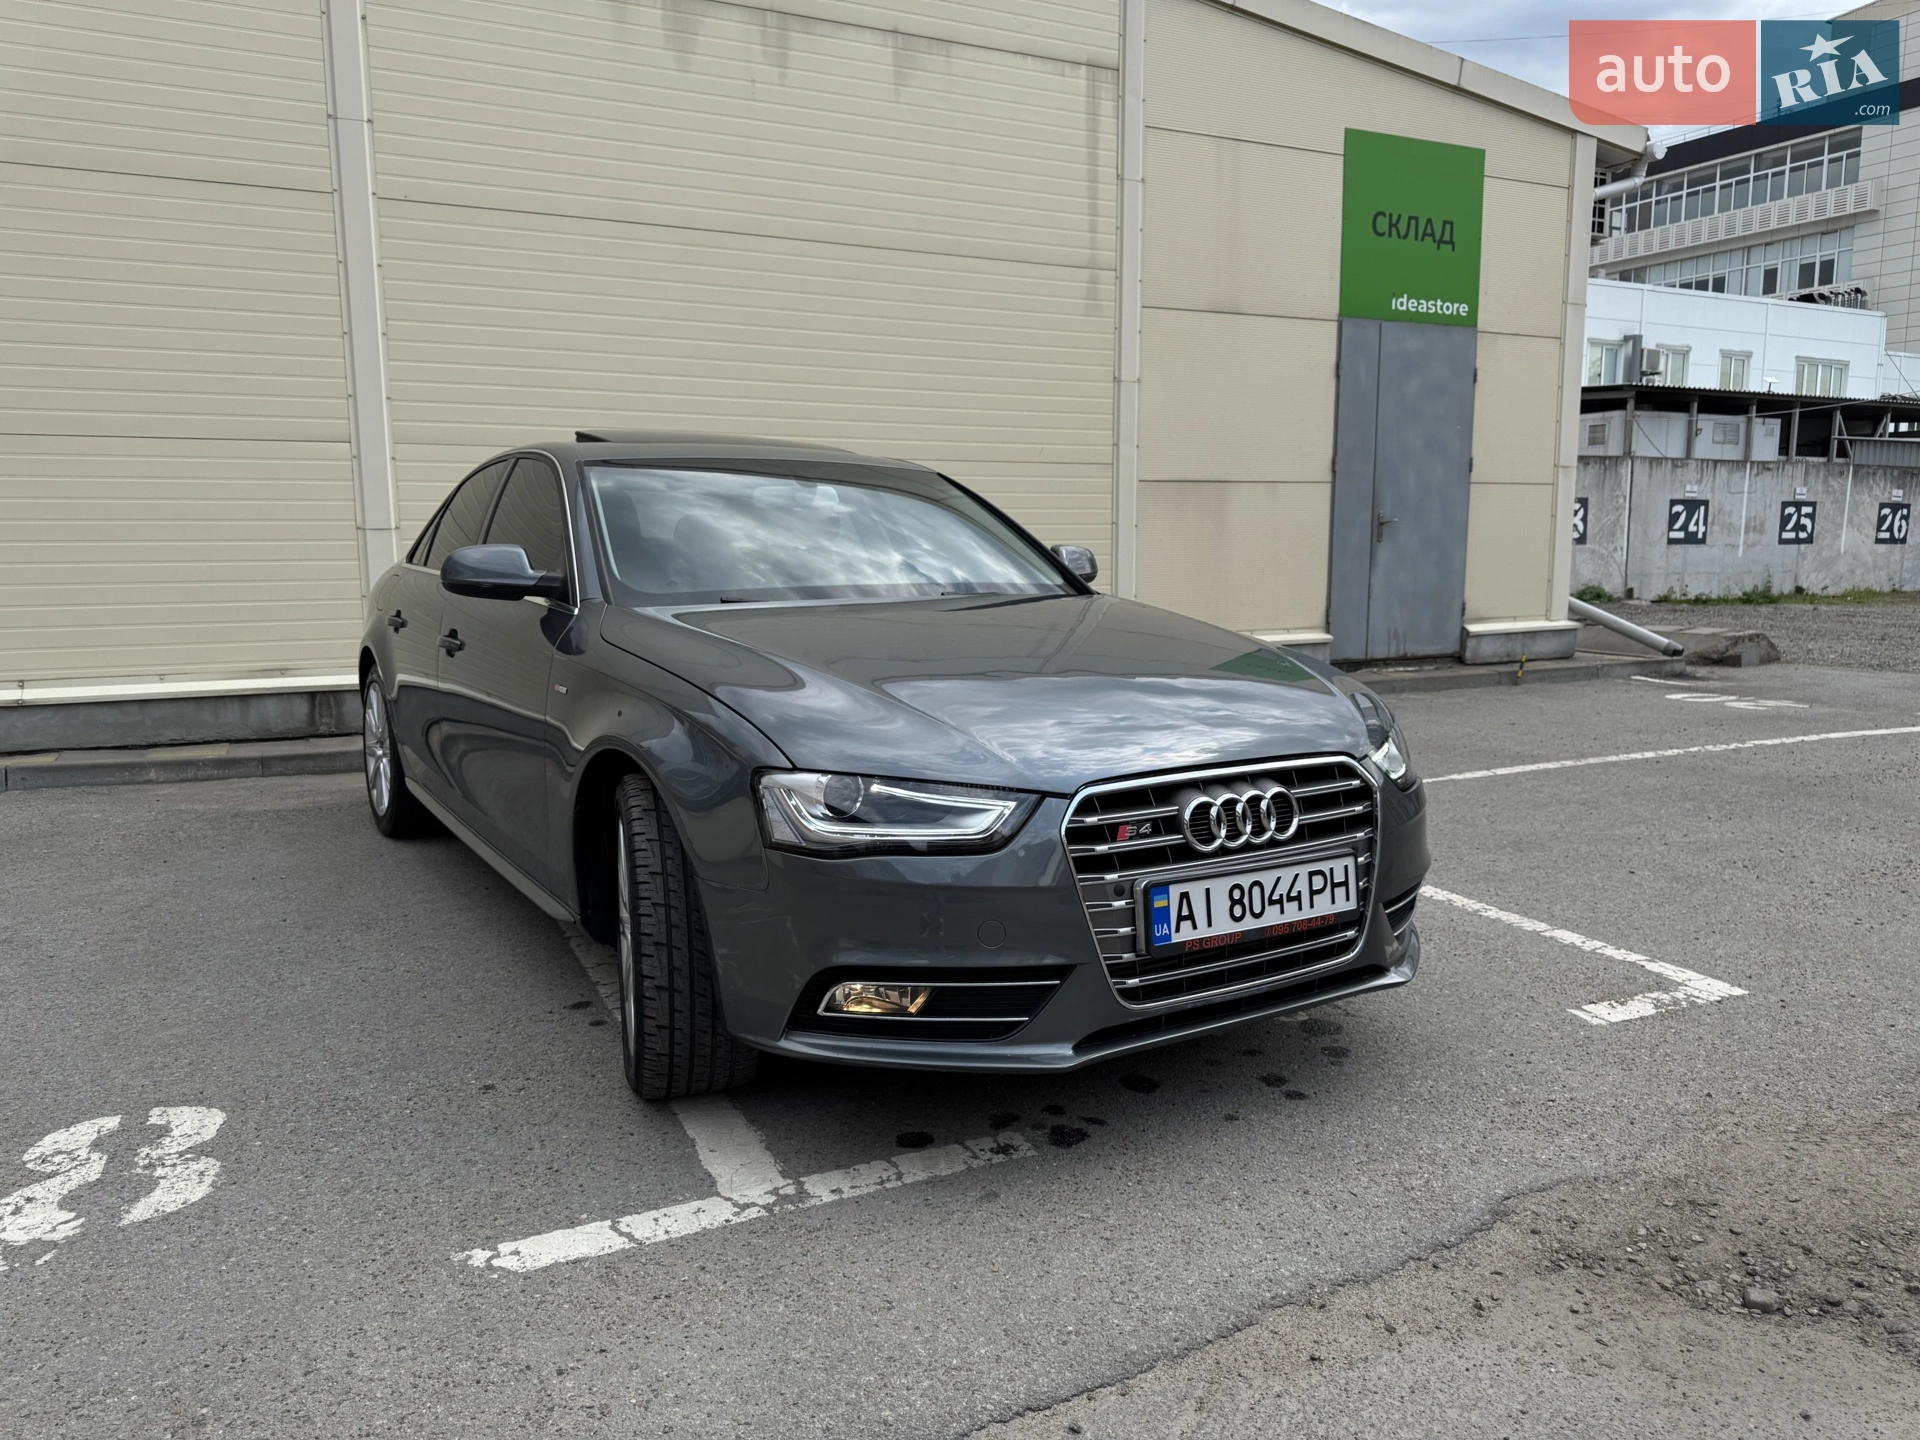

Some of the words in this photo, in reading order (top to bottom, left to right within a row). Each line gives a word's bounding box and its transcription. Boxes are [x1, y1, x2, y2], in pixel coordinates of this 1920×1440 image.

[1371, 210, 1457, 252] СКЛАД
[1391, 293, 1469, 316] ideastore
[1668, 504, 1706, 539] 24
[1781, 505, 1813, 540] 25
[1876, 507, 1909, 540] 26
[1123, 823, 1153, 837] S4
[1174, 886, 1213, 934] AI
[1154, 921, 1170, 937] UA
[1185, 937, 1200, 952] PS
[1272, 923, 1290, 937] 095
[1292, 913, 1336, 932] 708-44-79
